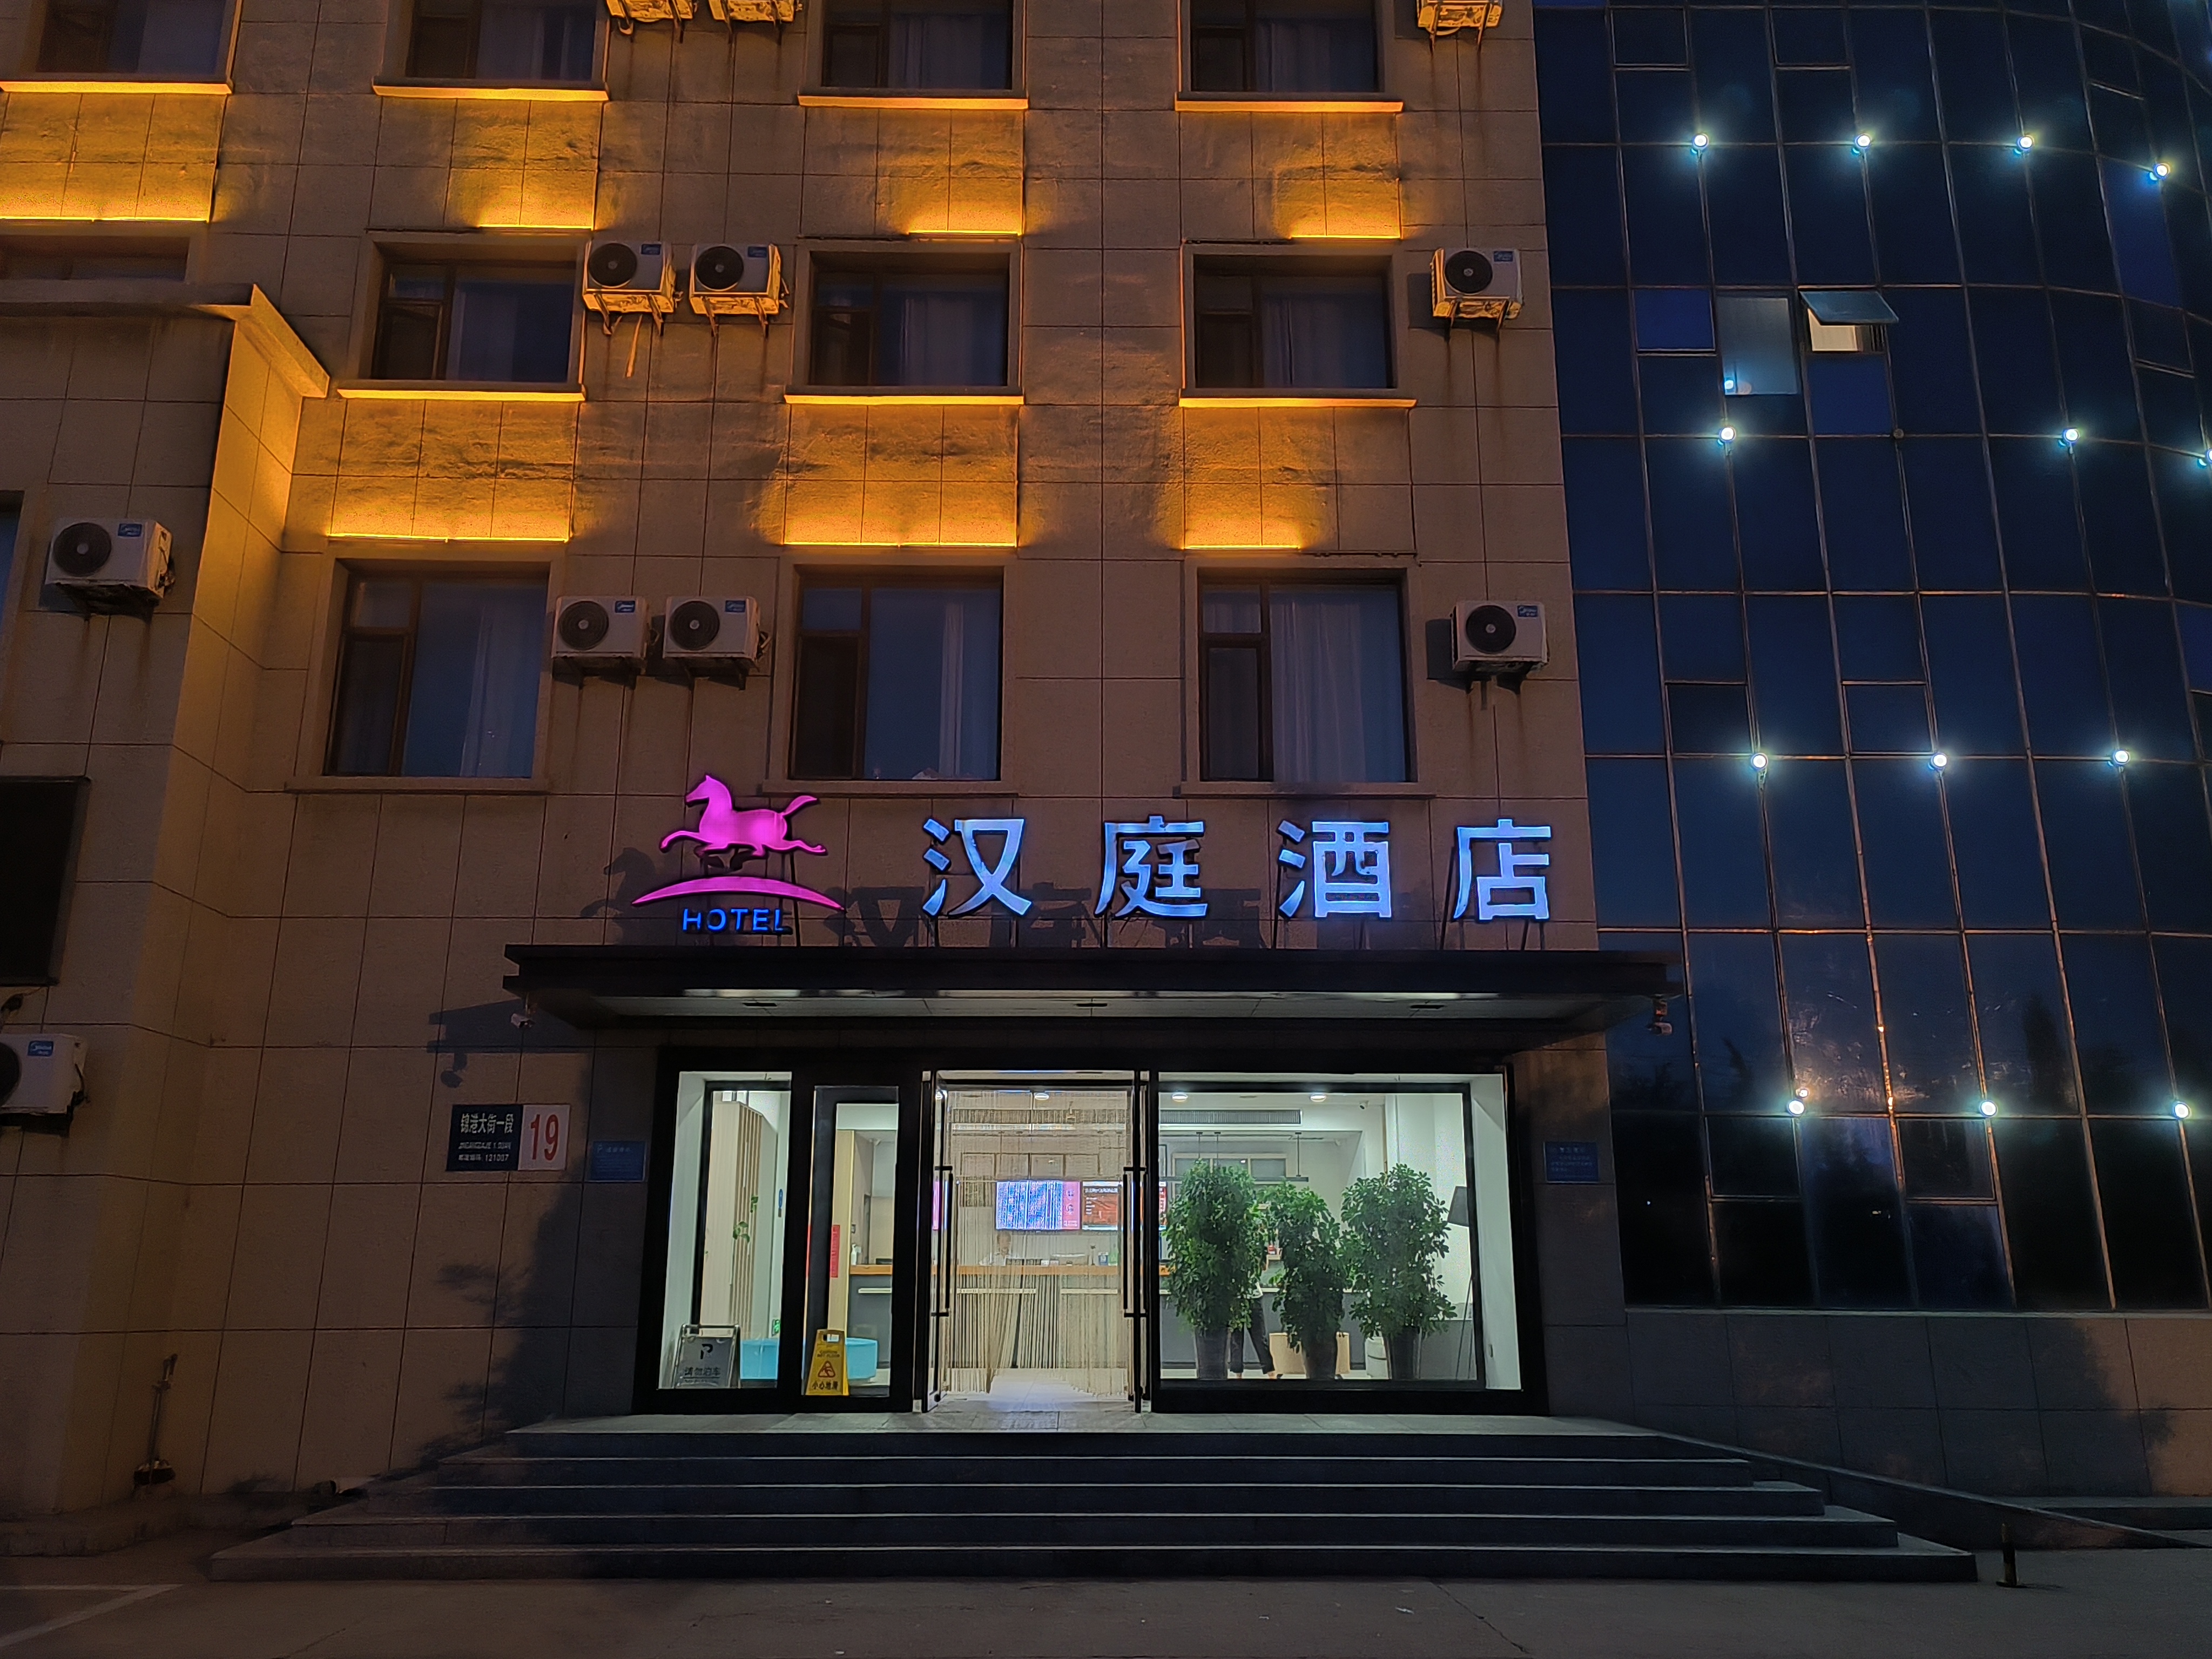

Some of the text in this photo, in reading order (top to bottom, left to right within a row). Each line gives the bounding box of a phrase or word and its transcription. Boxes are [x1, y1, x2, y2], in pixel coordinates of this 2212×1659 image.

[923, 816, 1552, 920] 汉庭酒店
[682, 908, 786, 933] HOTEL
[530, 1114, 559, 1161] 19
